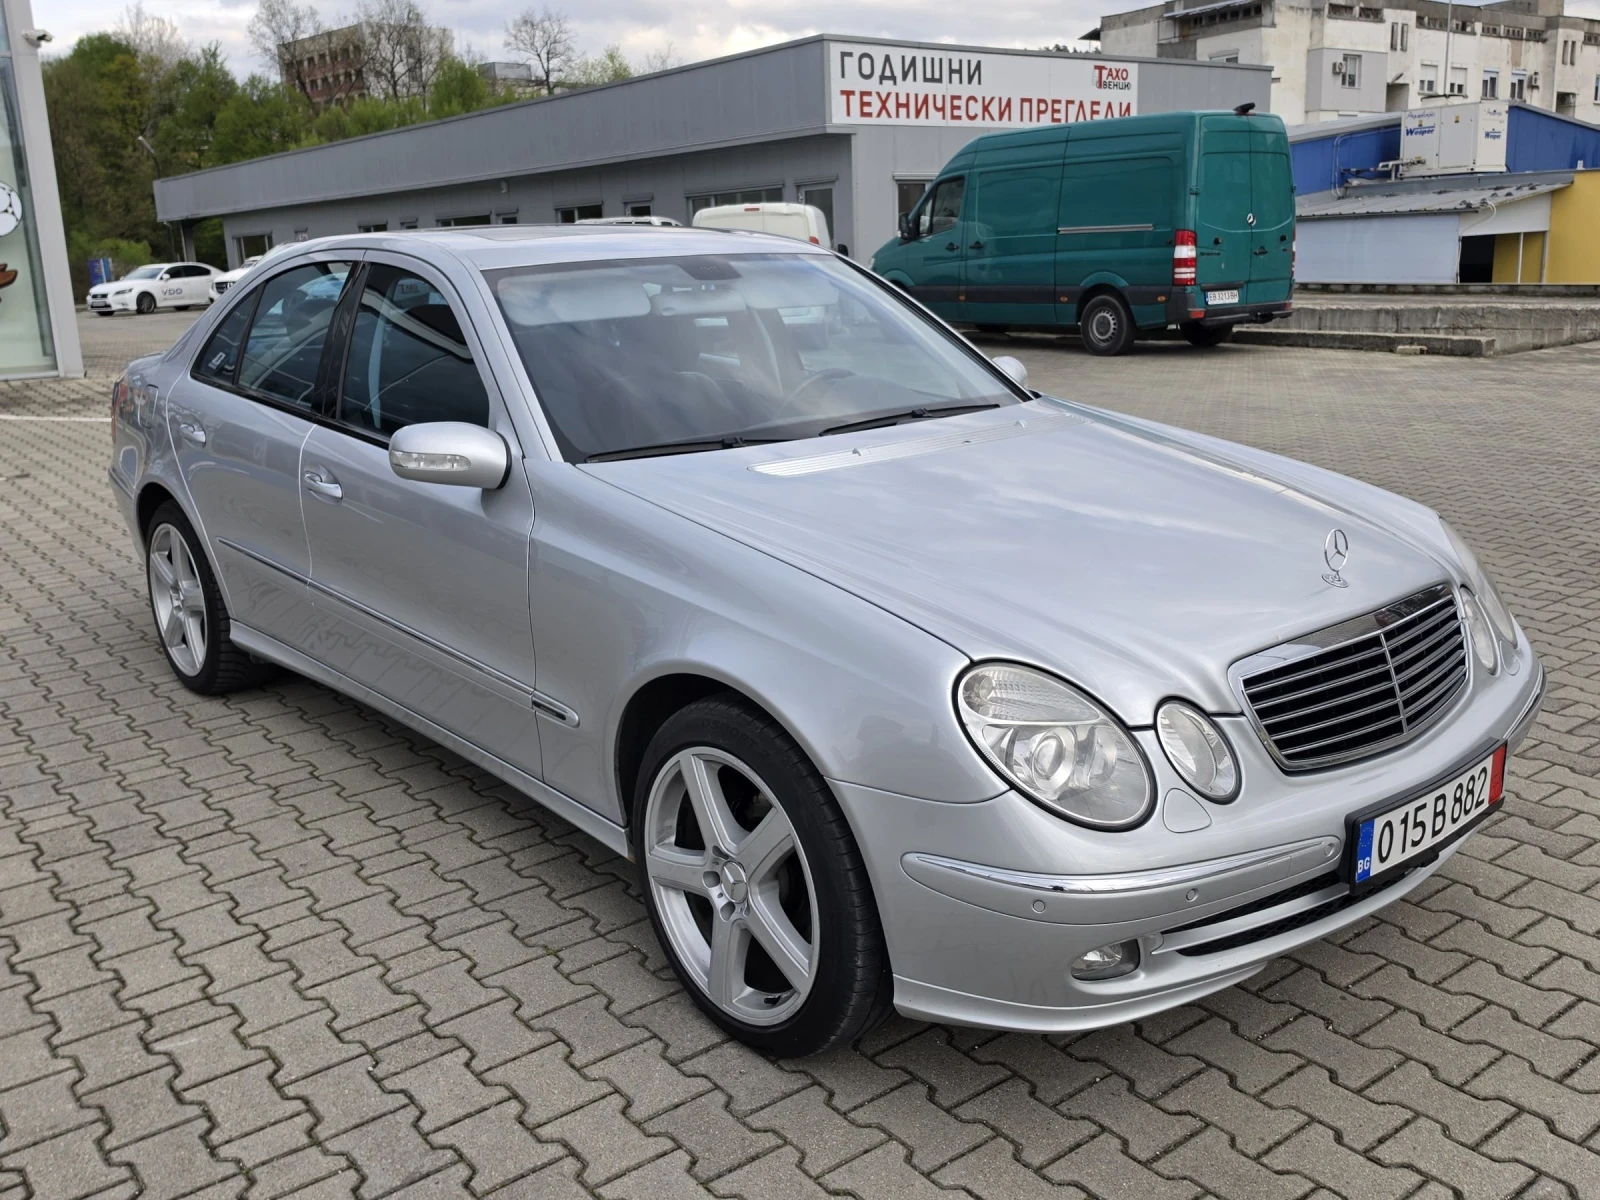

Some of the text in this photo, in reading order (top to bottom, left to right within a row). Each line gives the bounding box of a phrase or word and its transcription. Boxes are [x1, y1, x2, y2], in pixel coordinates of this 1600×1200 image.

[840, 51, 982, 86] ГОДИШНИ
[840, 89, 1011, 122] ТЕХНИЧЕСКИ
[1357, 856, 1371, 874] BG
